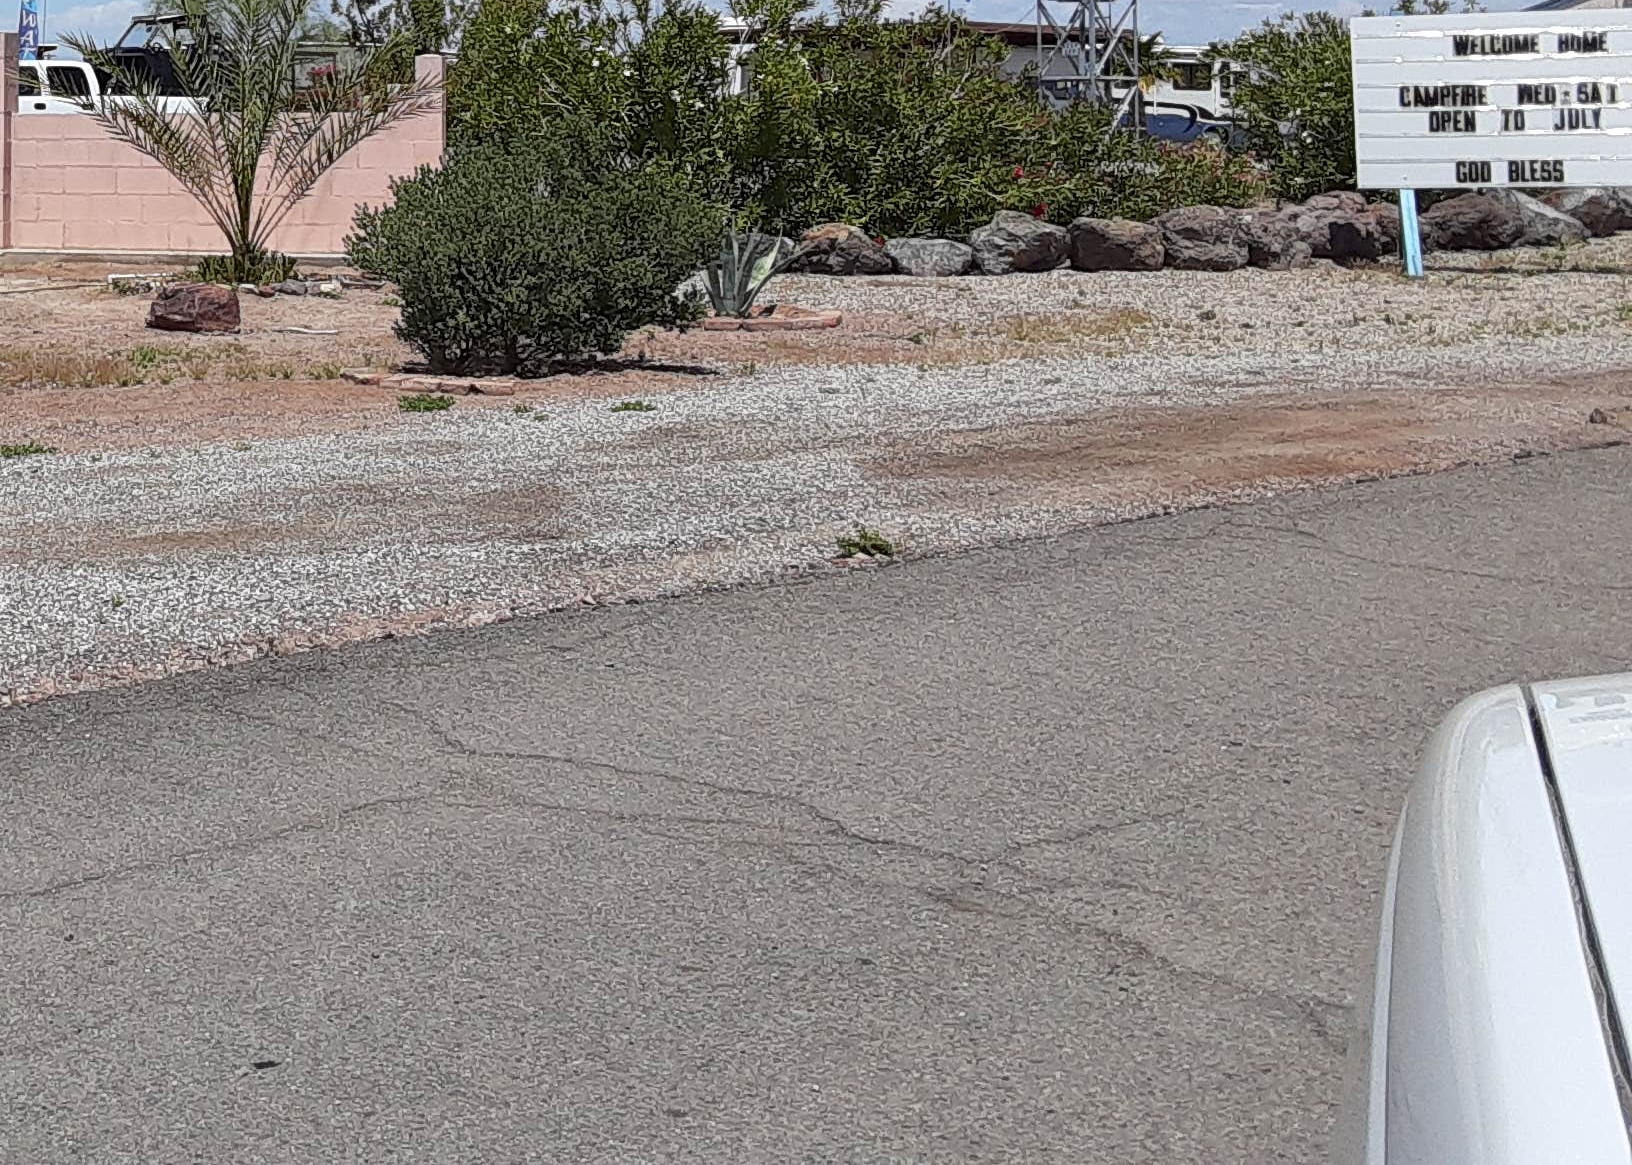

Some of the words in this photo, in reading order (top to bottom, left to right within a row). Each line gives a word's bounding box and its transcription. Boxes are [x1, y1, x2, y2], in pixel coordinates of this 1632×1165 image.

[1452, 34, 1540, 56] WELCOME
[1558, 31, 1607, 52] HOME
[1399, 85, 1488, 107] CAMPFIRE
[1429, 110, 1476, 133] OPEN
[1501, 109, 1525, 132] TO
[1553, 107, 1602, 131] JULY
[1456, 160, 1492, 183] GOD
[1508, 160, 1565, 183] BLESS
